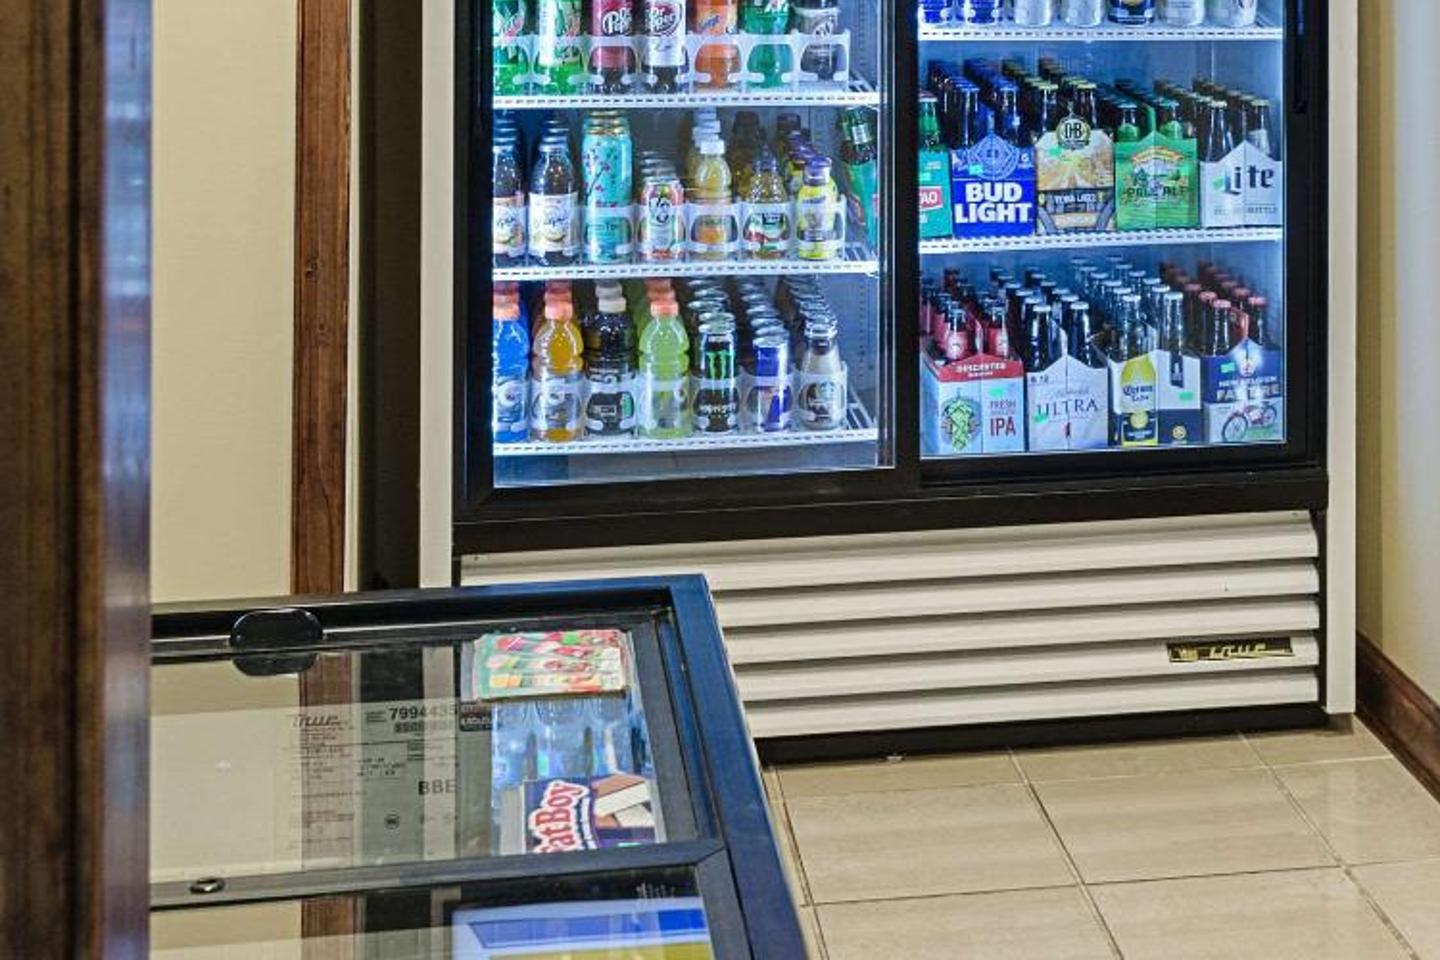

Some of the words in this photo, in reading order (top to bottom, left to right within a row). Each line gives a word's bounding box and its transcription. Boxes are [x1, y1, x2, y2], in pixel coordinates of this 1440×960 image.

[965, 182, 1022, 203] BUD
[954, 202, 1032, 224] LIGHT
[1037, 398, 1098, 419] ULTRA
[990, 416, 1016, 436] IPA
